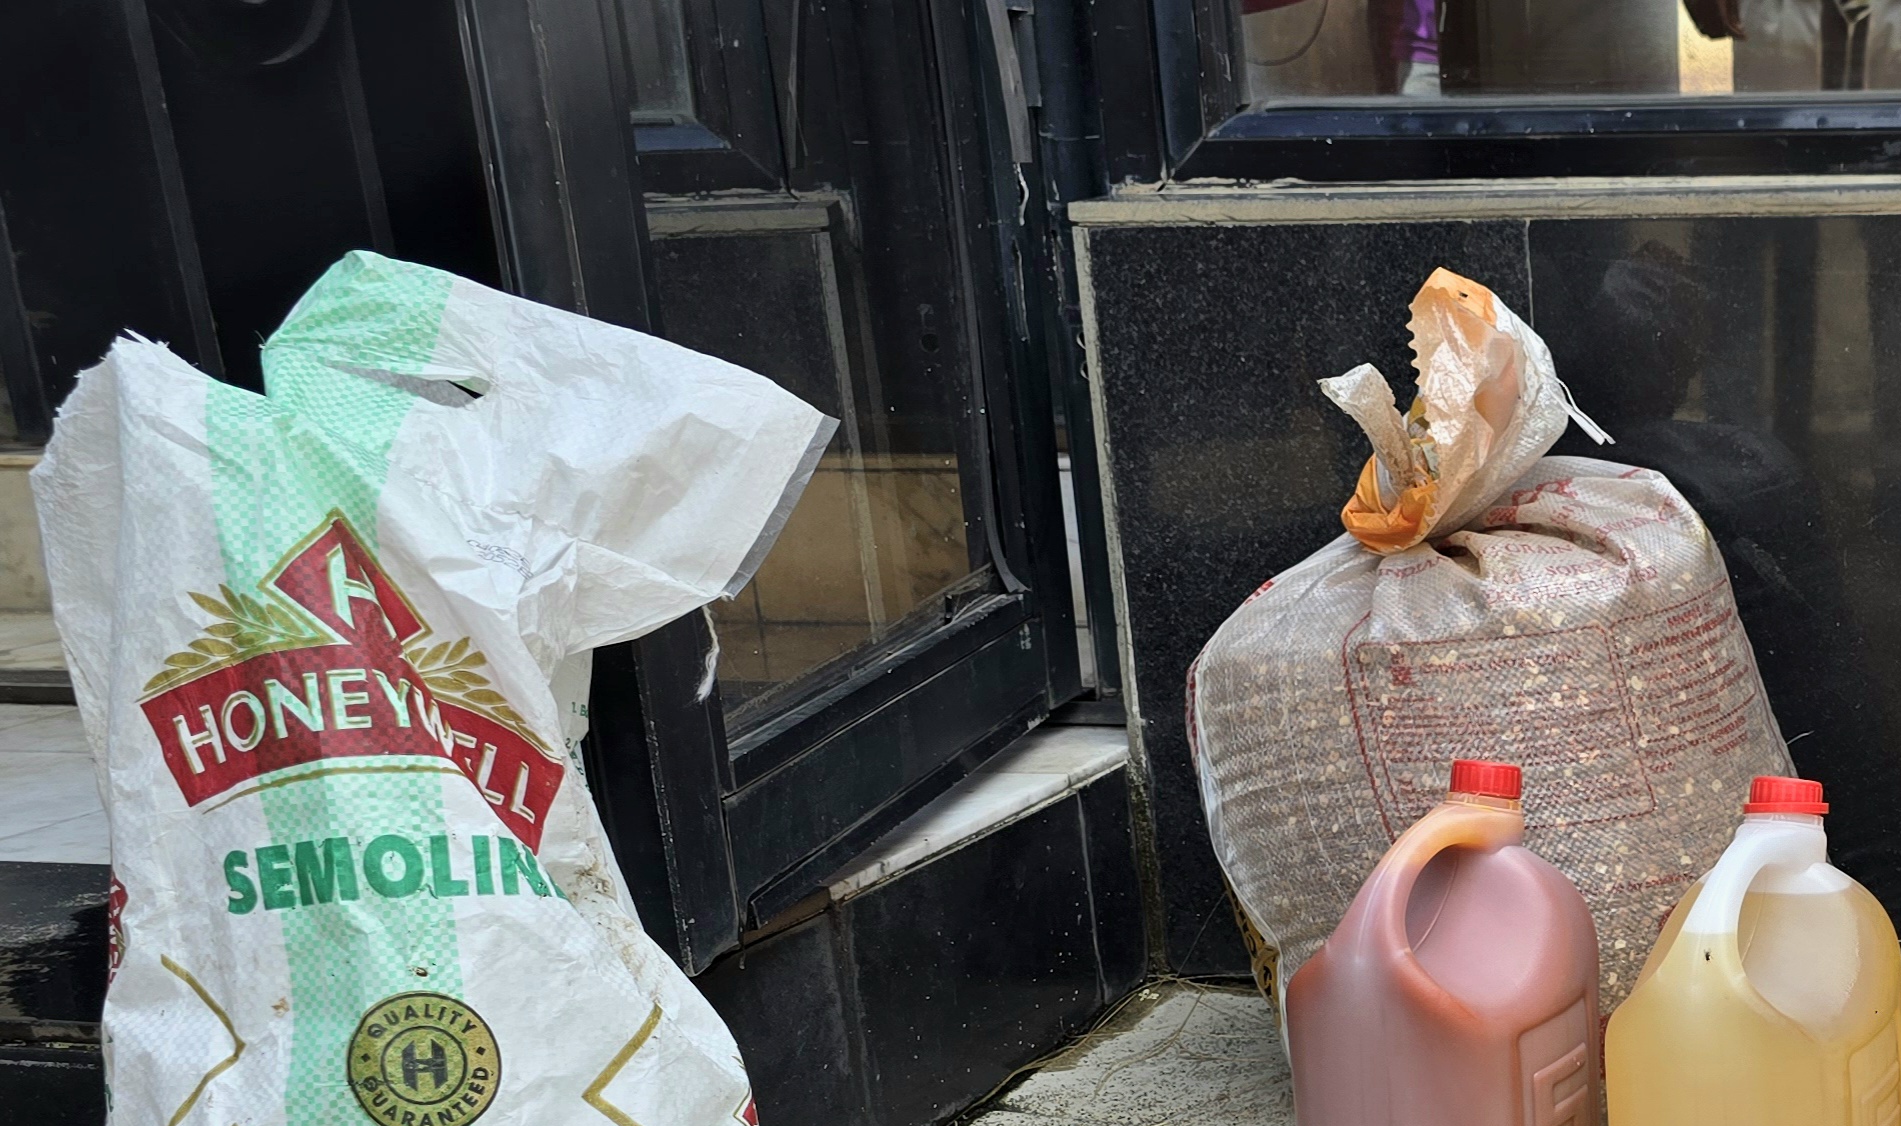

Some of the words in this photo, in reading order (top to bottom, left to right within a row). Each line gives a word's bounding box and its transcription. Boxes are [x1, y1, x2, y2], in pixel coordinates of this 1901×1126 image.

[328, 543, 398, 643] H
[224, 833, 570, 915] SEMOLIN
[367, 1003, 478, 1038] QUALITY
